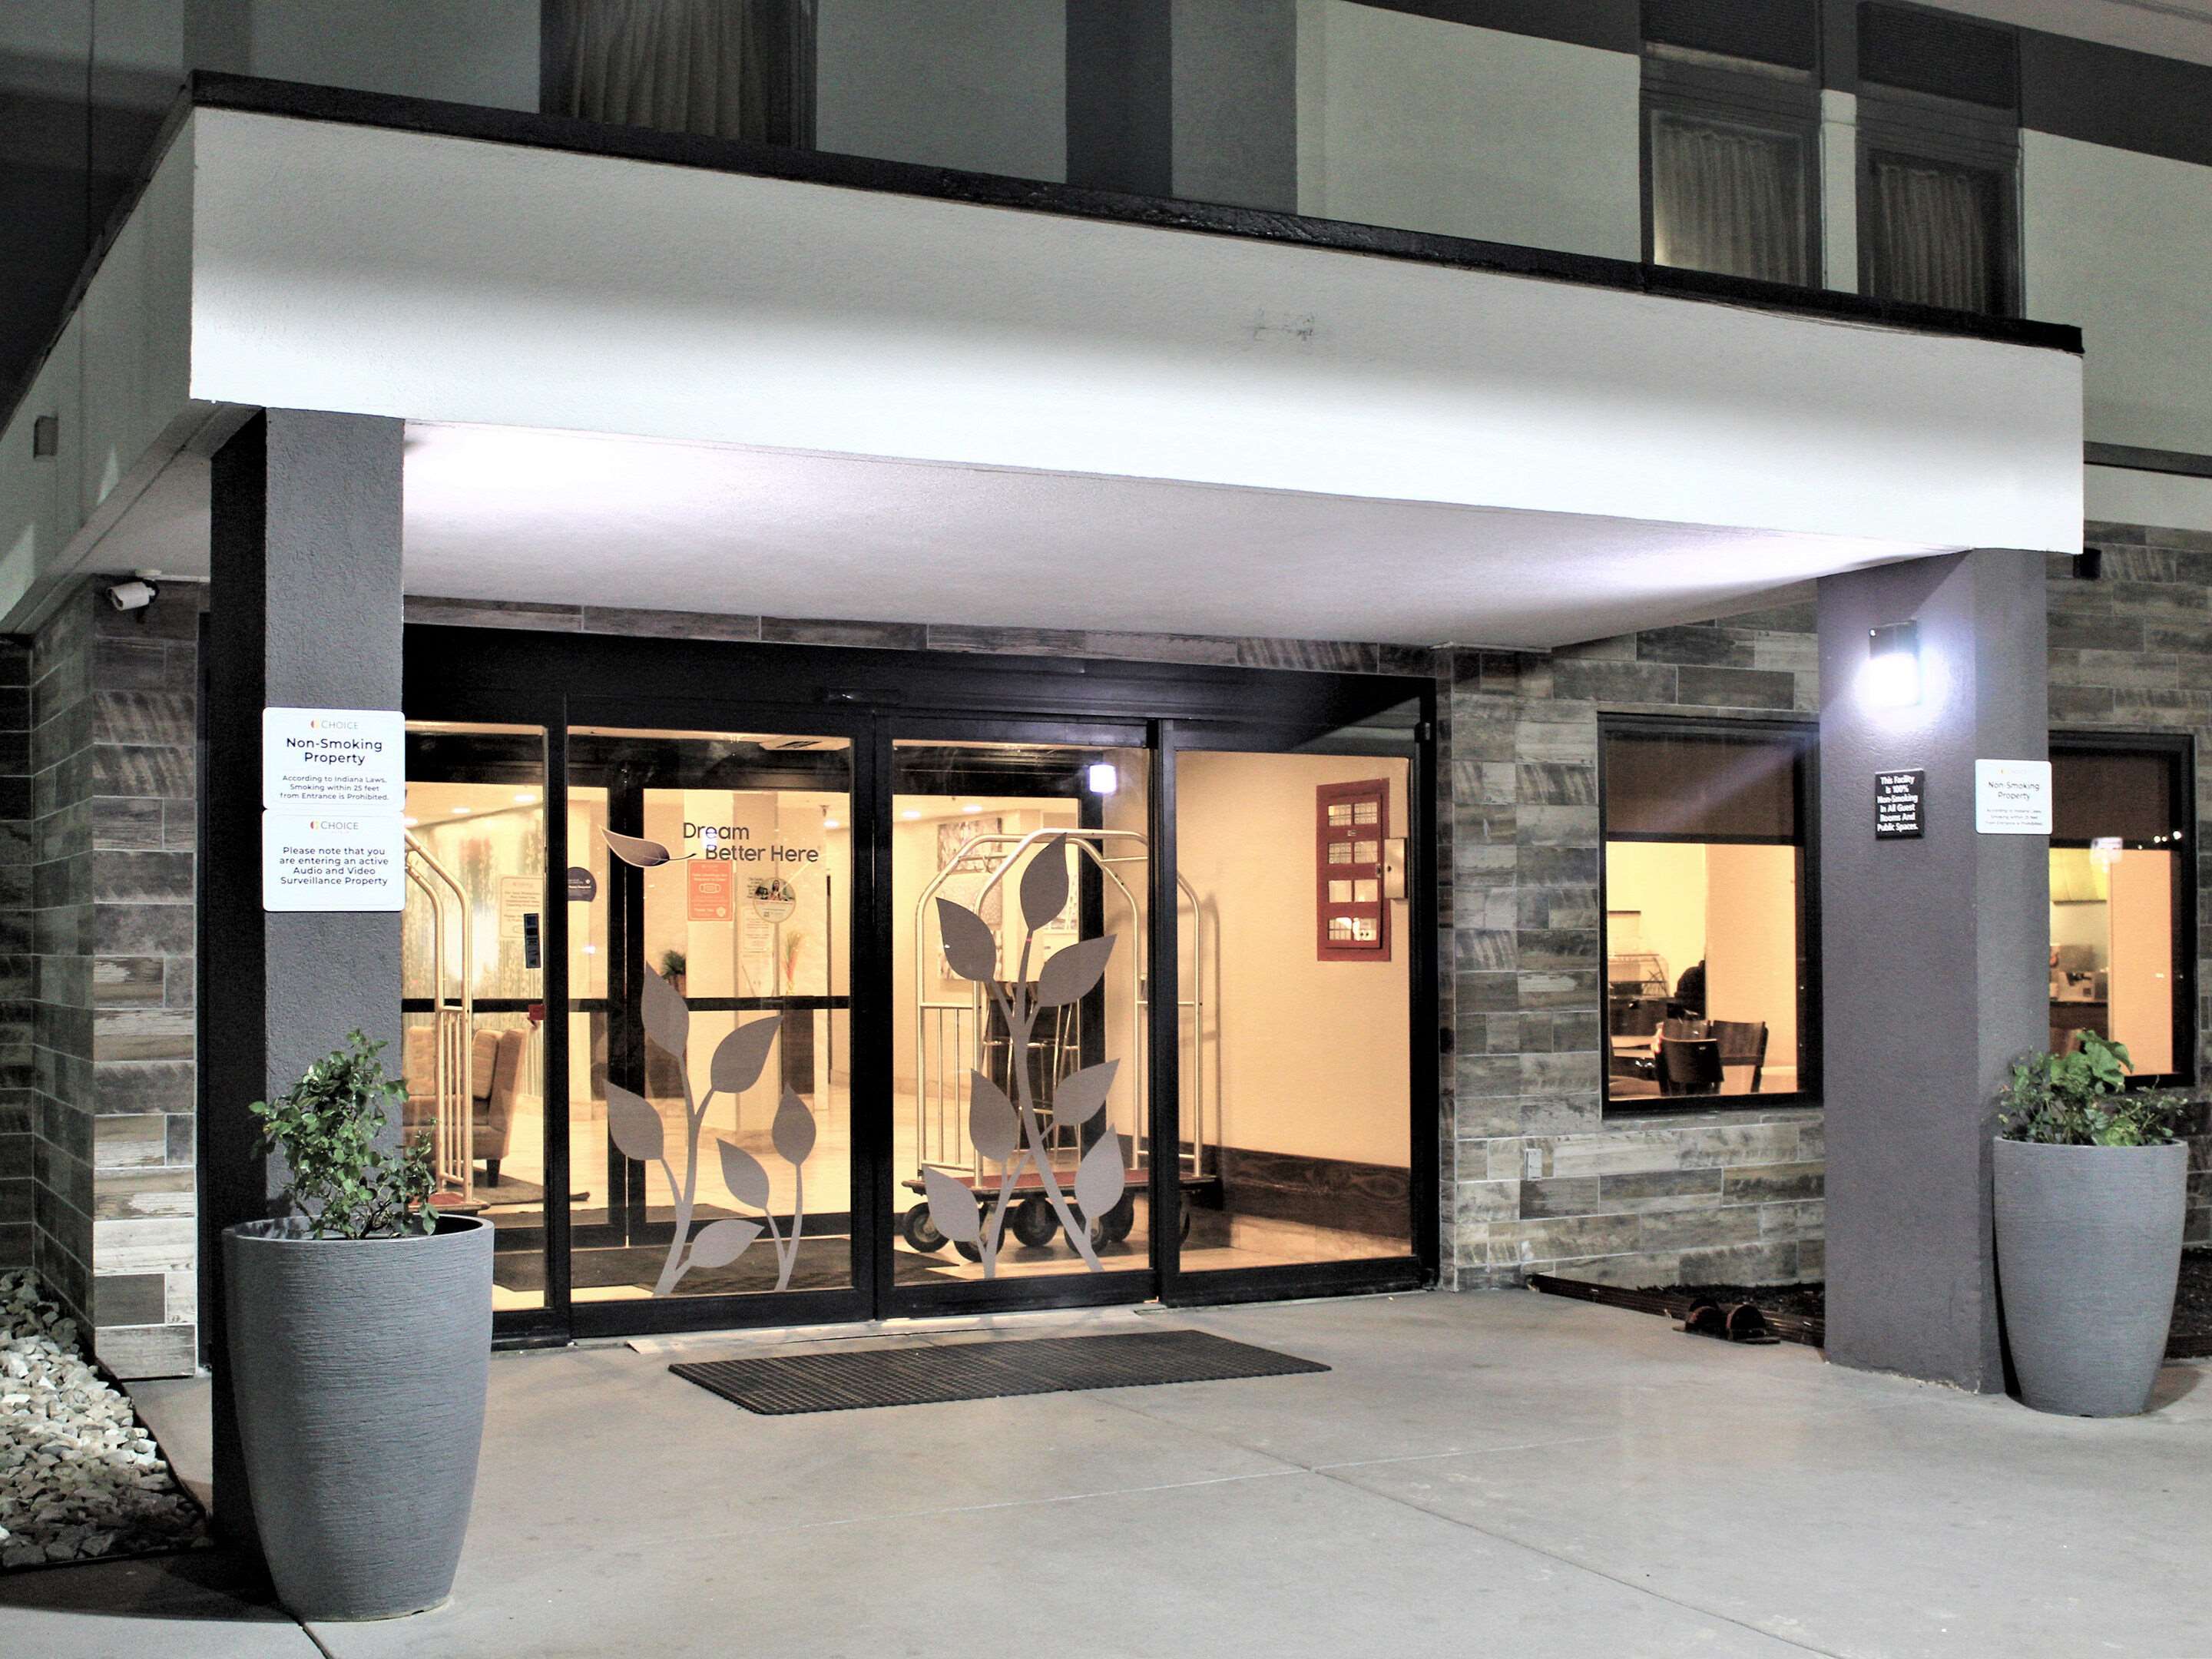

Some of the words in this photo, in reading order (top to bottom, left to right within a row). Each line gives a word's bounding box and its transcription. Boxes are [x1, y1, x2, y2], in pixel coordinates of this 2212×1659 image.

[321, 720, 359, 730] CHOICE
[286, 737, 382, 752] Non-Smoking
[304, 752, 366, 766] Property
[1880, 776, 1893, 784] This
[1893, 775, 1915, 784] Facility
[290, 783, 325, 792] Smoking
[1877, 794, 1918, 803] Non-Smoking
[1998, 791, 2030, 801] Property
[1902, 812, 1916, 820] And
[320, 821, 359, 830] CHOICE
[683, 822, 750, 840] Dream
[283, 846, 316, 855] Please
[367, 849, 386, 857] you
[705, 844, 766, 862] Better
[770, 845, 819, 863] Here
[298, 857, 341, 866] entering
[359, 857, 389, 866] active
[293, 866, 323, 875] Audio
[326, 866, 345, 875] and
[347, 866, 376, 876] Video
[280, 876, 343, 885] Surveillance
[345, 877, 388, 887] Property
